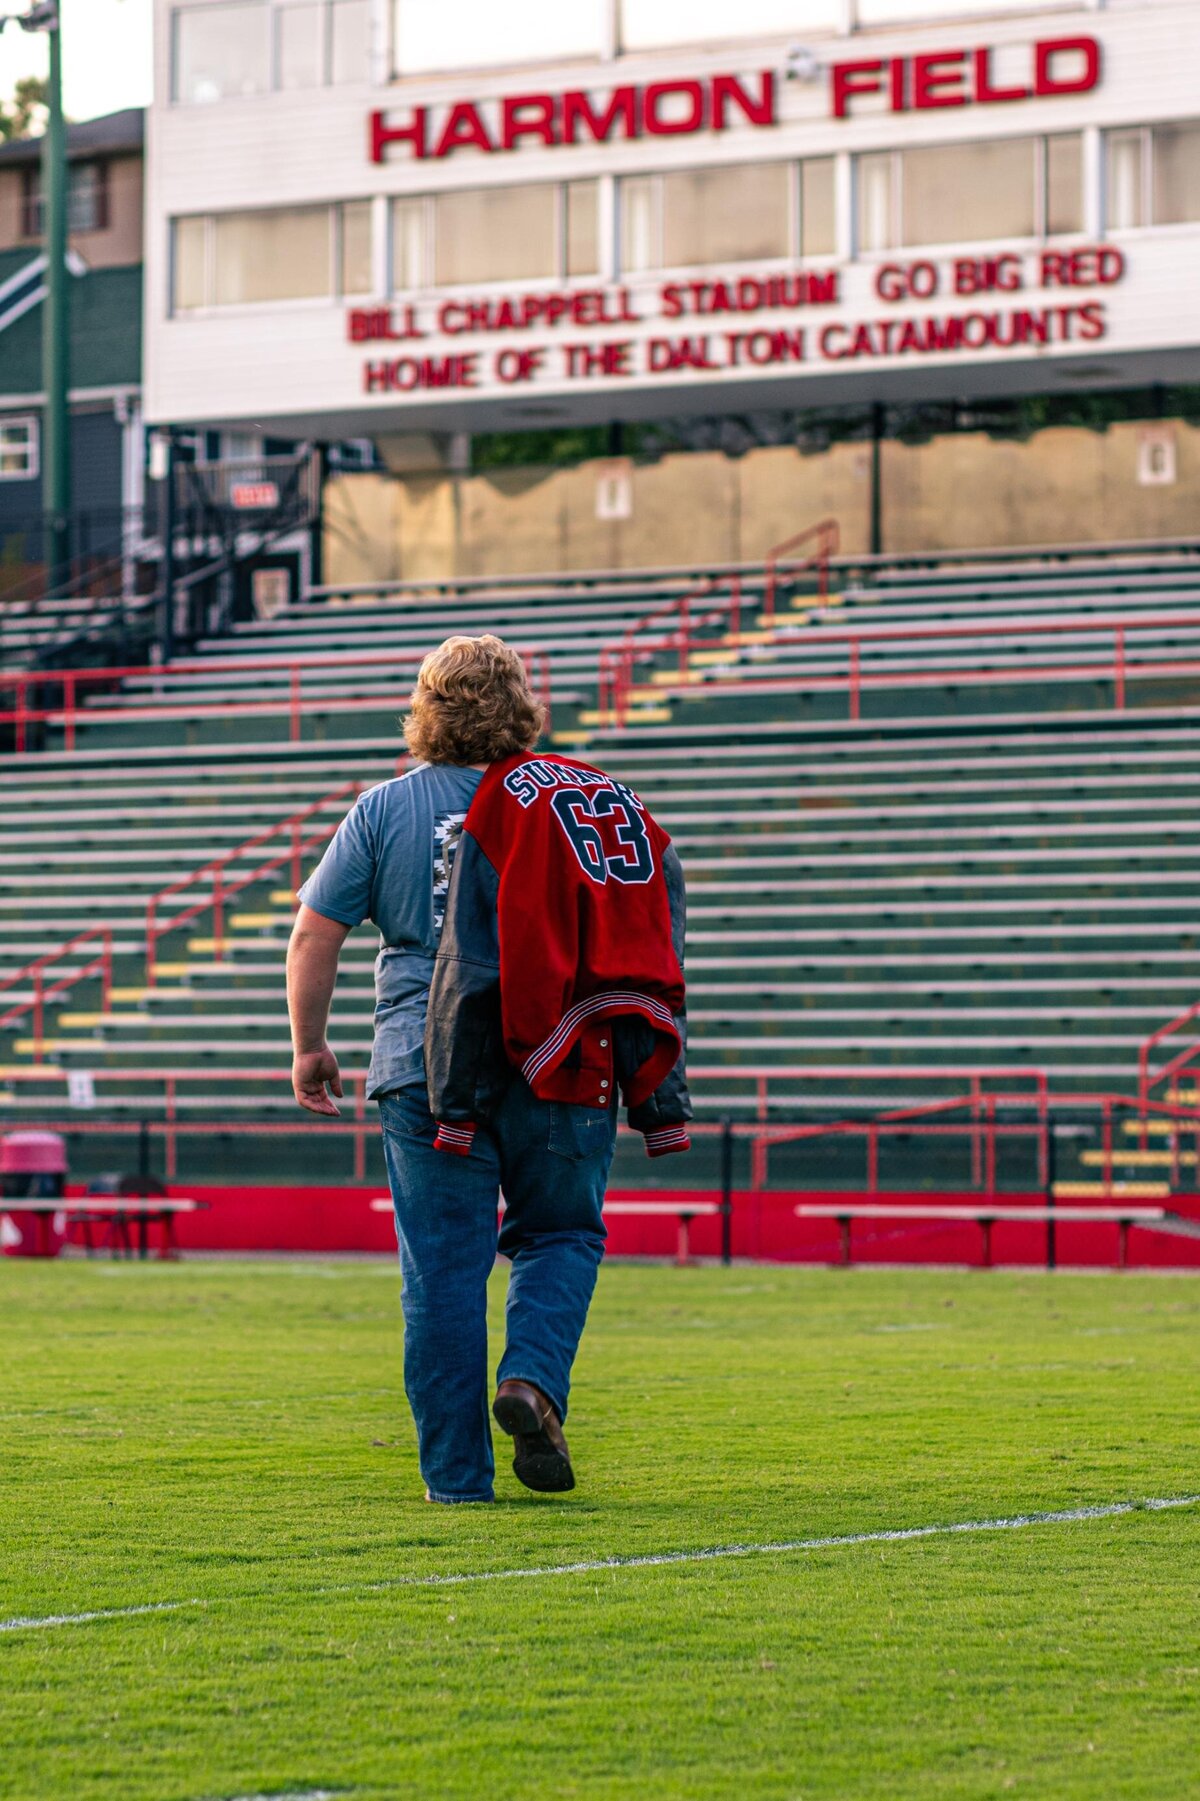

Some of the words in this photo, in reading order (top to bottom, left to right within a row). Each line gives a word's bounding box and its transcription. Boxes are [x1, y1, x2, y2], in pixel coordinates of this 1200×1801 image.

[369, 68, 774, 163] HARMON
[830, 35, 1101, 118] FIELD
[347, 304, 423, 342] BILL
[437, 284, 642, 335] CHAPPELL
[660, 271, 837, 318] STADIUM
[875, 260, 938, 301] GO
[952, 253, 1021, 295] BIG
[1038, 245, 1123, 287] RED
[363, 352, 478, 393] HOME
[495, 346, 546, 383] OF
[563, 340, 632, 377] THE
[646, 327, 804, 373] DALTON
[817, 300, 1105, 360] CATAMOUNTS
[550, 788, 655, 885] 63
